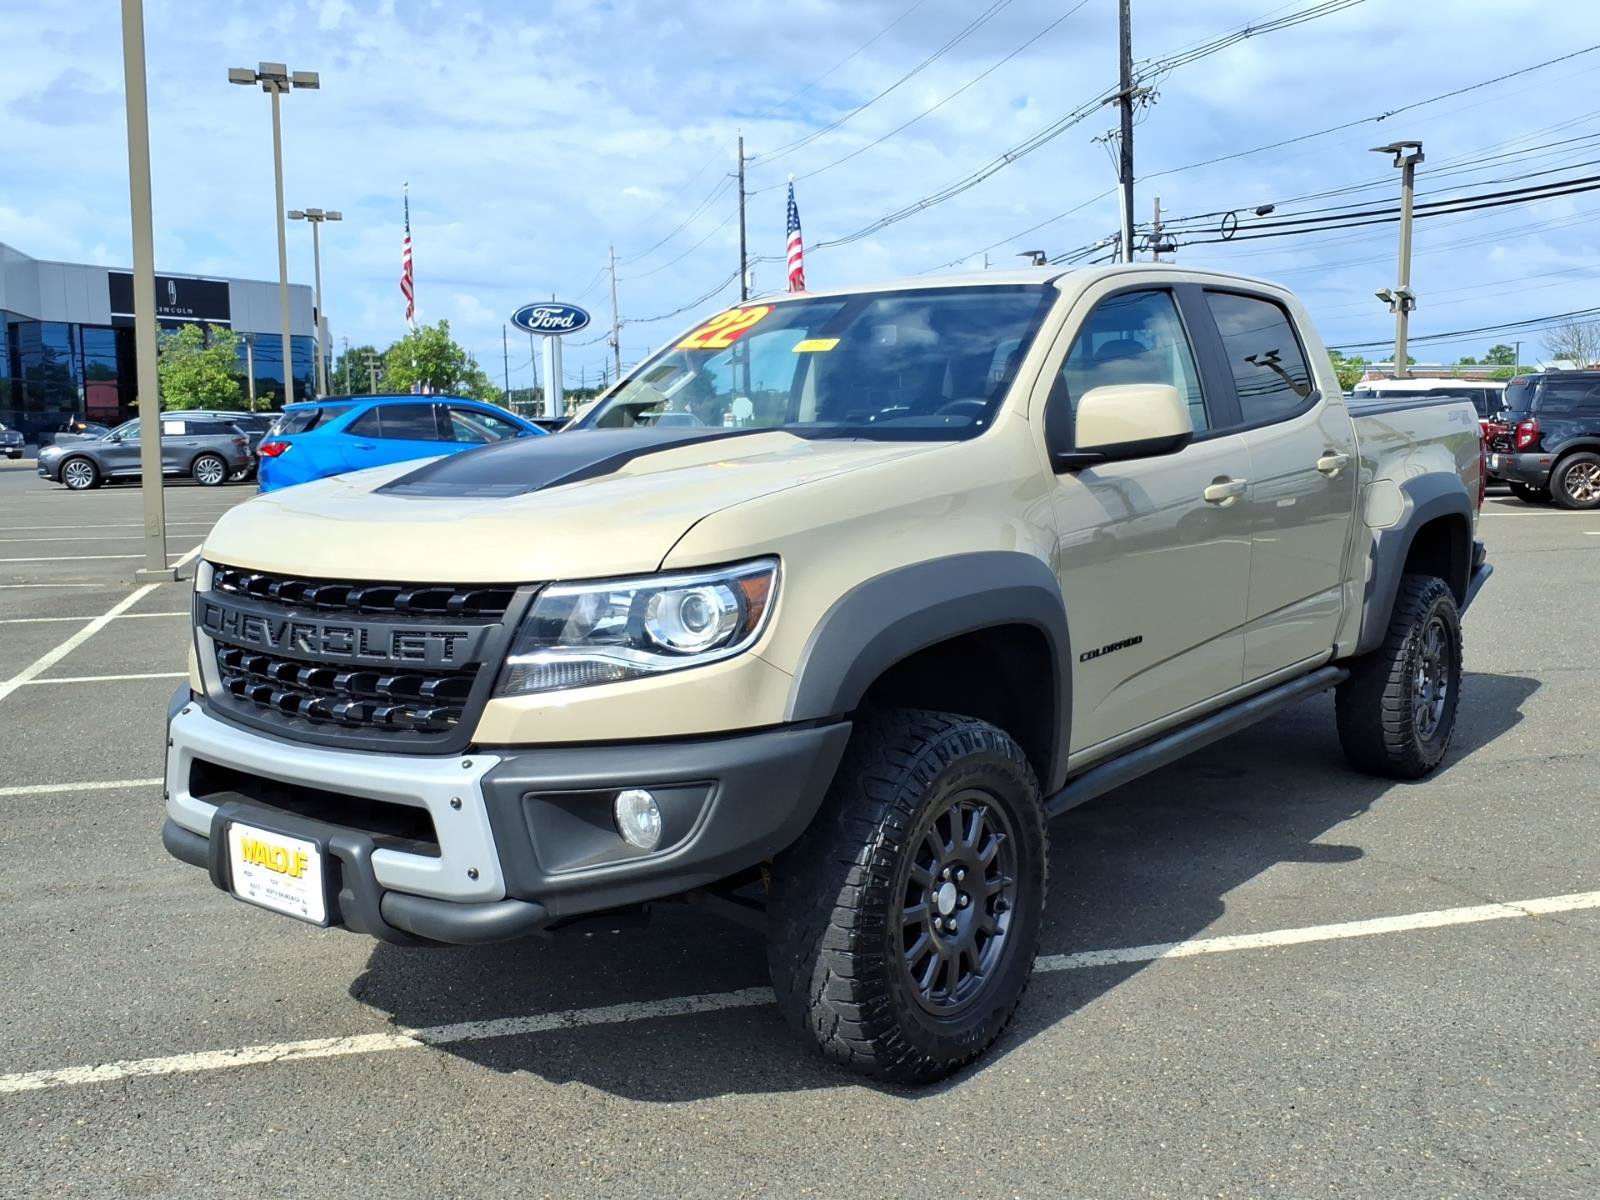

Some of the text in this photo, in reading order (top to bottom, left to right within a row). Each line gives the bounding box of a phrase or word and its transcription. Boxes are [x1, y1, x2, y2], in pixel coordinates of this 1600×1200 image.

[156, 306, 193, 314] INCOLN
[528, 308, 575, 327] Ford
[675, 305, 772, 349] 22
[203, 603, 468, 662] CHEVROLET
[1080, 635, 1143, 662] COLORADO
